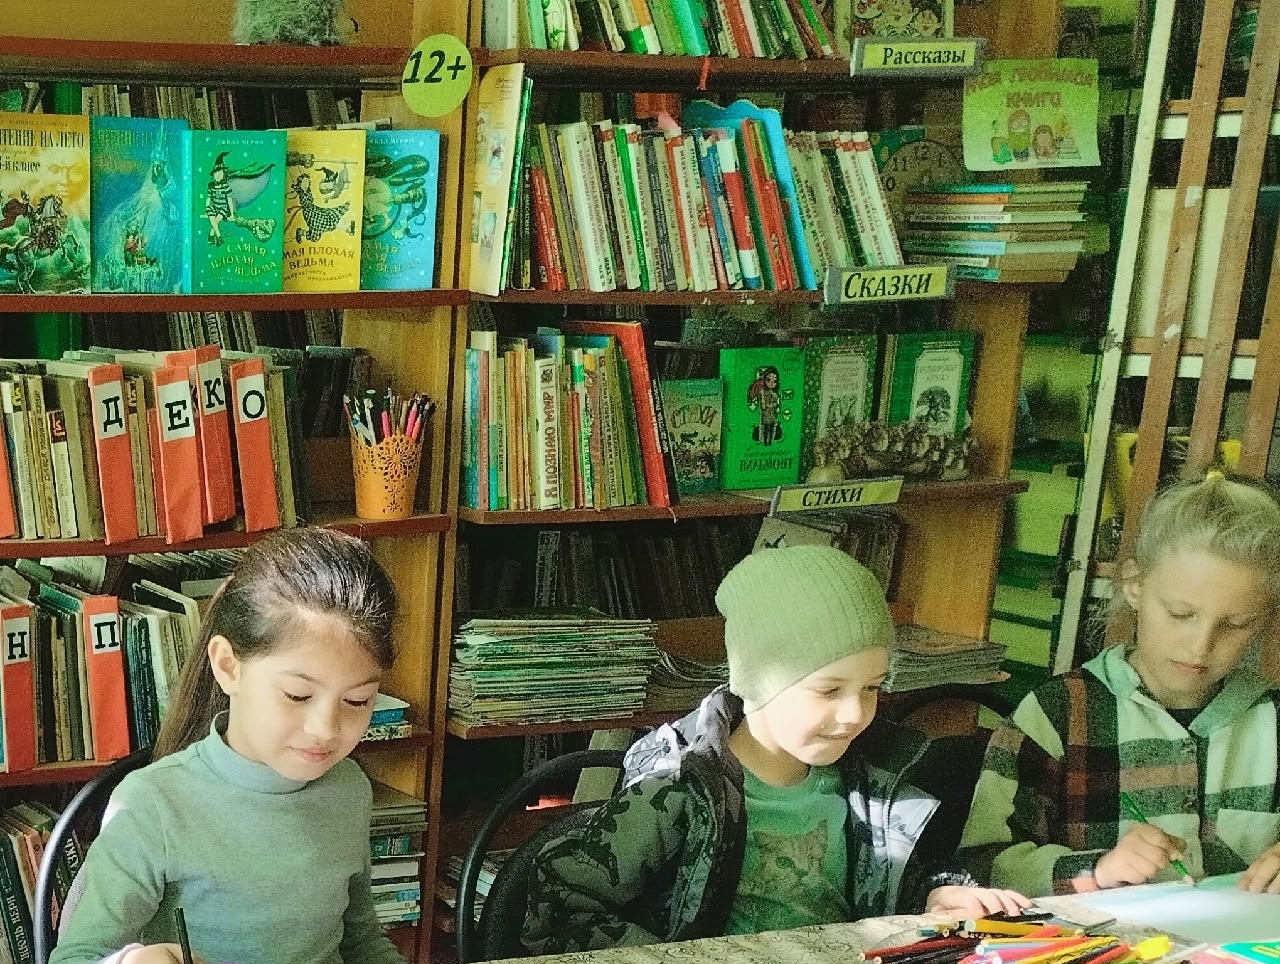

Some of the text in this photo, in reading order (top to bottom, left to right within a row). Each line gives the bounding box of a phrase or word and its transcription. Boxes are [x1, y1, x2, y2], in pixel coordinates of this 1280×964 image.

[401, 49, 467, 85] 12+
[882, 47, 967, 66] Рассказы
[283, 246, 355, 260] МАЯ ПЛОХАЯ
[289, 258, 334, 270] ВЕДЬМА
[203, 377, 225, 409] К
[242, 389, 266, 420] О
[101, 395, 123, 433] Д
[164, 400, 191, 431] Е
[671, 404, 718, 428] СТИХИ
[542, 391, 557, 498] Я ПОЗНАЮ МИР
[7, 630, 29, 660] Н
[93, 621, 120, 650] П
